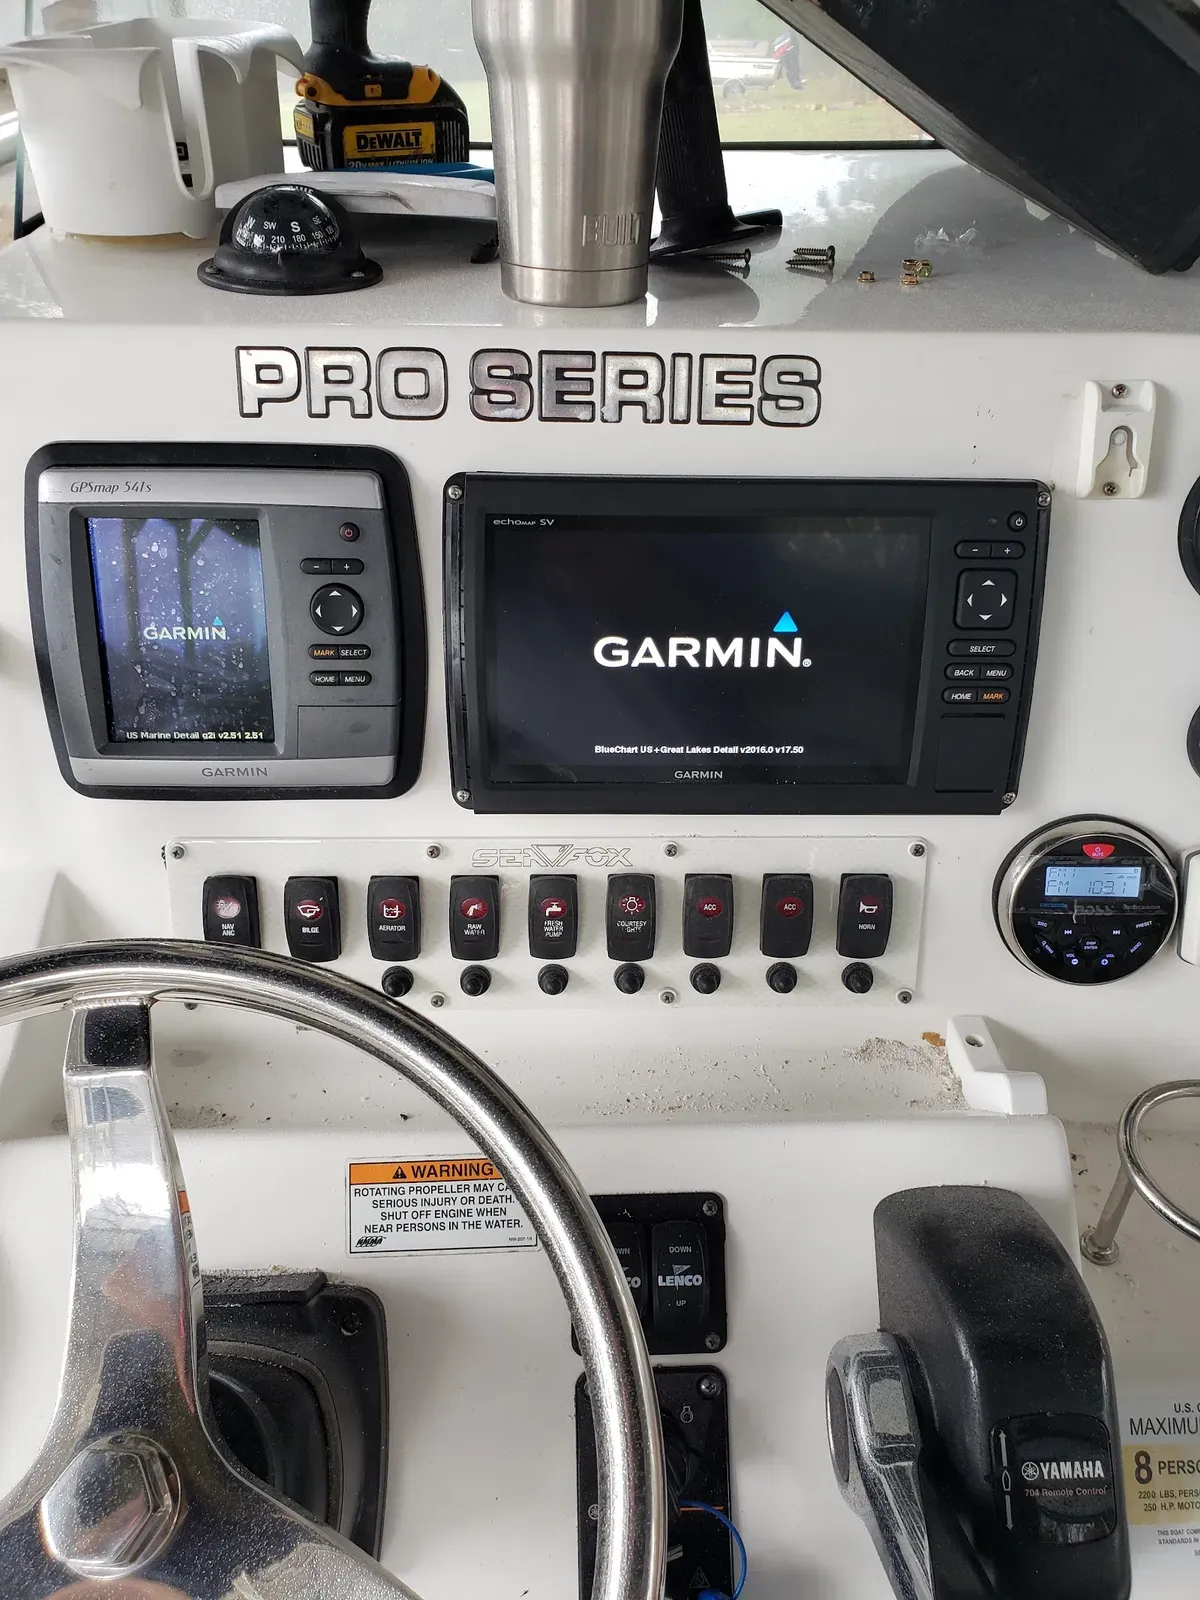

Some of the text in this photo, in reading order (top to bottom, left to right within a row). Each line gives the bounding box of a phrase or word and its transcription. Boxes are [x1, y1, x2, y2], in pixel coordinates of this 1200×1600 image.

[263, 221, 277, 230] SW
[290, 221, 301, 233] S
[271, 235, 286, 244] 210
[292, 233, 307, 243] 180
[236, 346, 821, 427] PRO SERIES
[70, 481, 120, 495] GPSmap
[540, 518, 555, 526] SV
[143, 625, 227, 641] GARMIN
[340, 649, 368, 657] SELECT
[969, 645, 996, 653] SELECT
[986, 669, 1007, 677] MENU
[314, 675, 366, 683] HOME MENU
[951, 692, 1005, 700] HOME MARK
[126, 731, 139, 740] US
[140, 731, 172, 740] Marine
[173, 731, 200, 740] Detail
[594, 744, 639, 754] BlueChart
[686, 745, 712, 754] Lakes
[713, 745, 739, 754] Detail
[740, 745, 774, 754] v2016.0
[775, 745, 804, 754] v17.50
[201, 766, 268, 778] GARMIN
[674, 770, 723, 779] GARMIN
[703, 903, 717, 911] ACC
[783, 903, 797, 911] ACC
[858, 923, 876, 931] HORN
[1135, 920, 1153, 929] PRESET
[411, 1162, 494, 1178] WARNING
[354, 1186, 406, 1197] ROTATING
[408, 1183, 471, 1195] PROPELLER
[473, 1182, 496, 1193] MAY
[372, 1194, 515, 1209] SERIOUS INJURY OR DEATH.
[380, 1206, 507, 1221] SHUT OFF ENGINE WHEN
[364, 1218, 523, 1234] NEAR PERSONS IN THE WATER.
[657, 1274, 703, 1287] LENCO
[1173, 1402, 1194, 1414] U.S.
[1129, 1417, 1200, 1436] MAXIMU
[1040, 1460, 1104, 1479] YAMAHA
[1134, 1450, 1153, 1485] 8
[1024, 1486, 1107, 1497] 704 Remote Control
[1138, 1490, 1156, 1500] 2200
[1178, 1488, 1200, 1498] PERS
[1143, 1503, 1157, 1512] 250
[1158, 1537, 1192, 1545] STANDARDS
